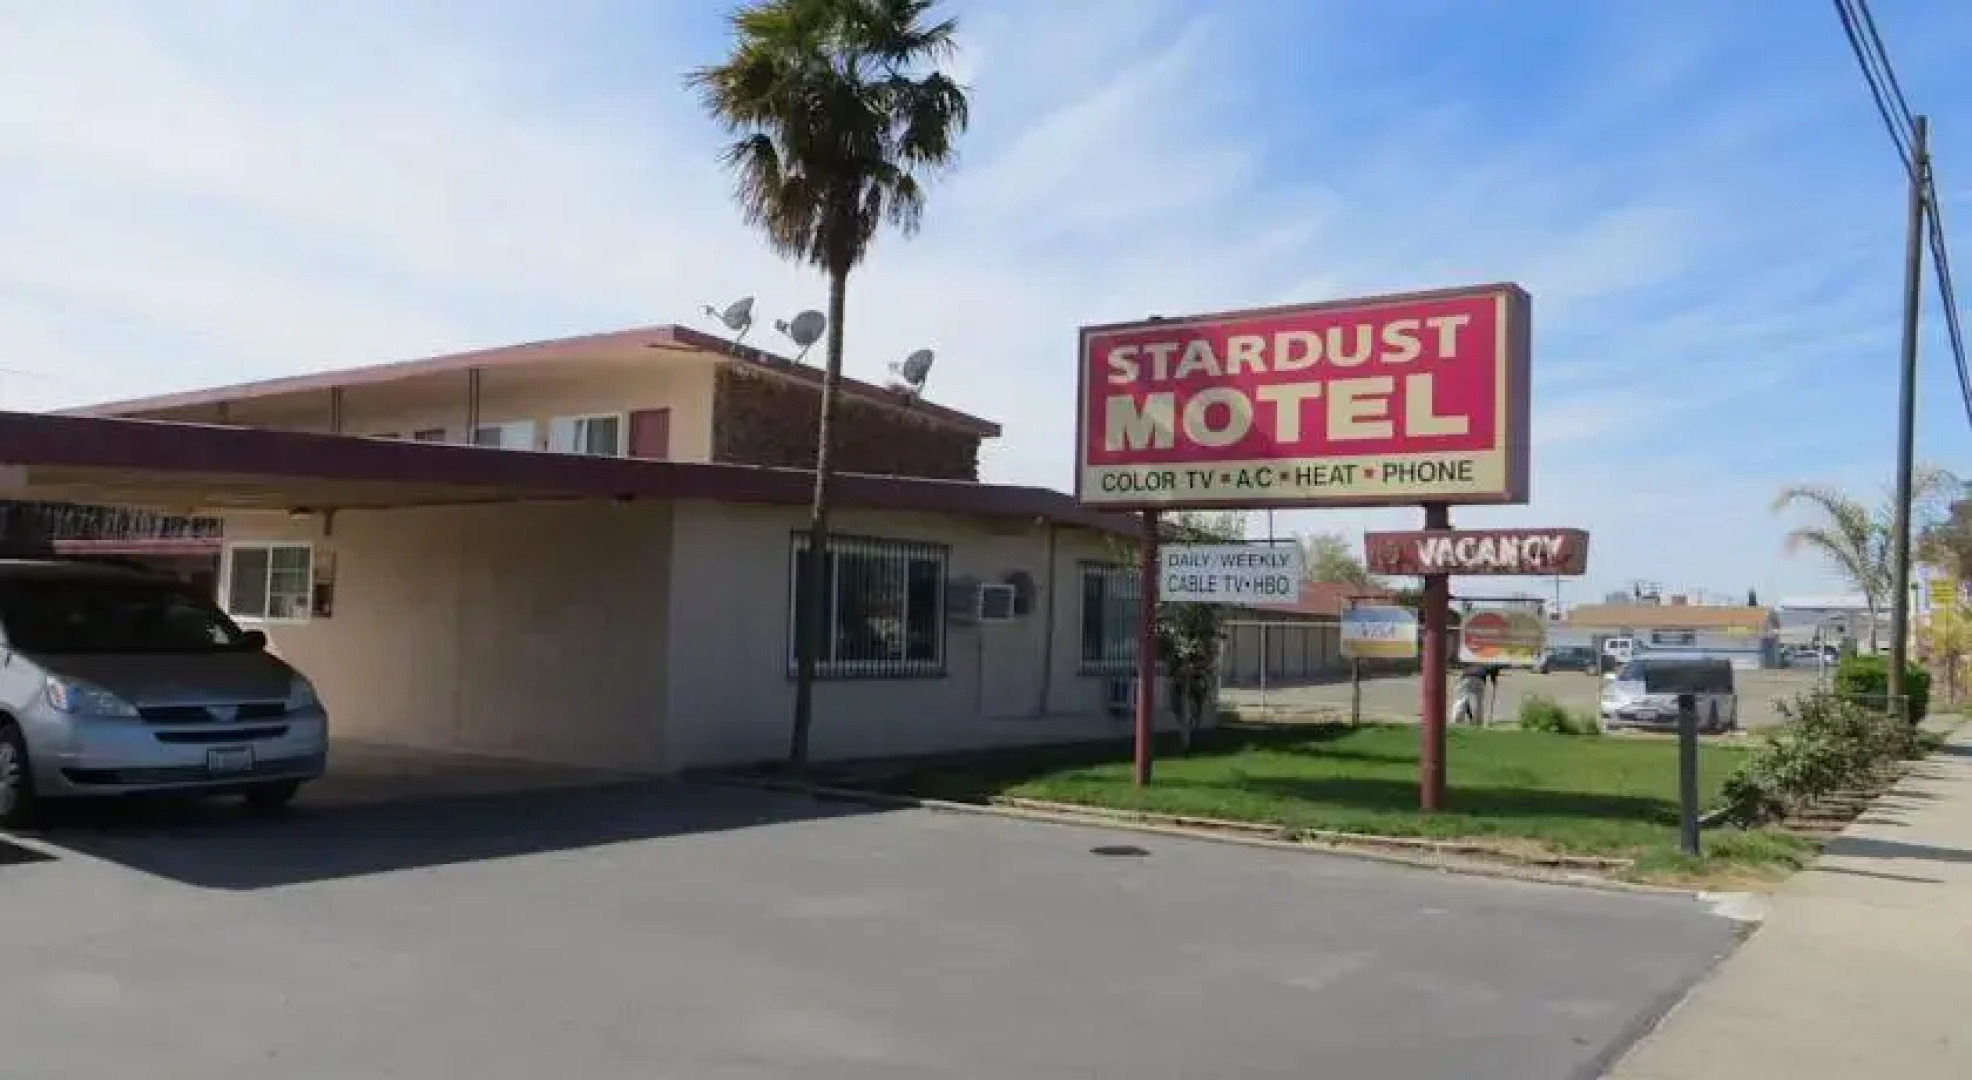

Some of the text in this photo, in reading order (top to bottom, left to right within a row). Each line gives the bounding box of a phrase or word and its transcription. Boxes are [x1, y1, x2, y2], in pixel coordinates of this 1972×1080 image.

[1107, 314, 1470, 384] STARDUST
[1105, 372, 1469, 452] MOTEL
[1102, 471, 1175, 491] COLOR
[1185, 469, 1215, 489] TV
[1295, 464, 1358, 486] HEAT
[1382, 459, 1474, 483] PHONE
[1415, 535, 1565, 567] VACANCY
[1167, 574, 1217, 593] CABLE
